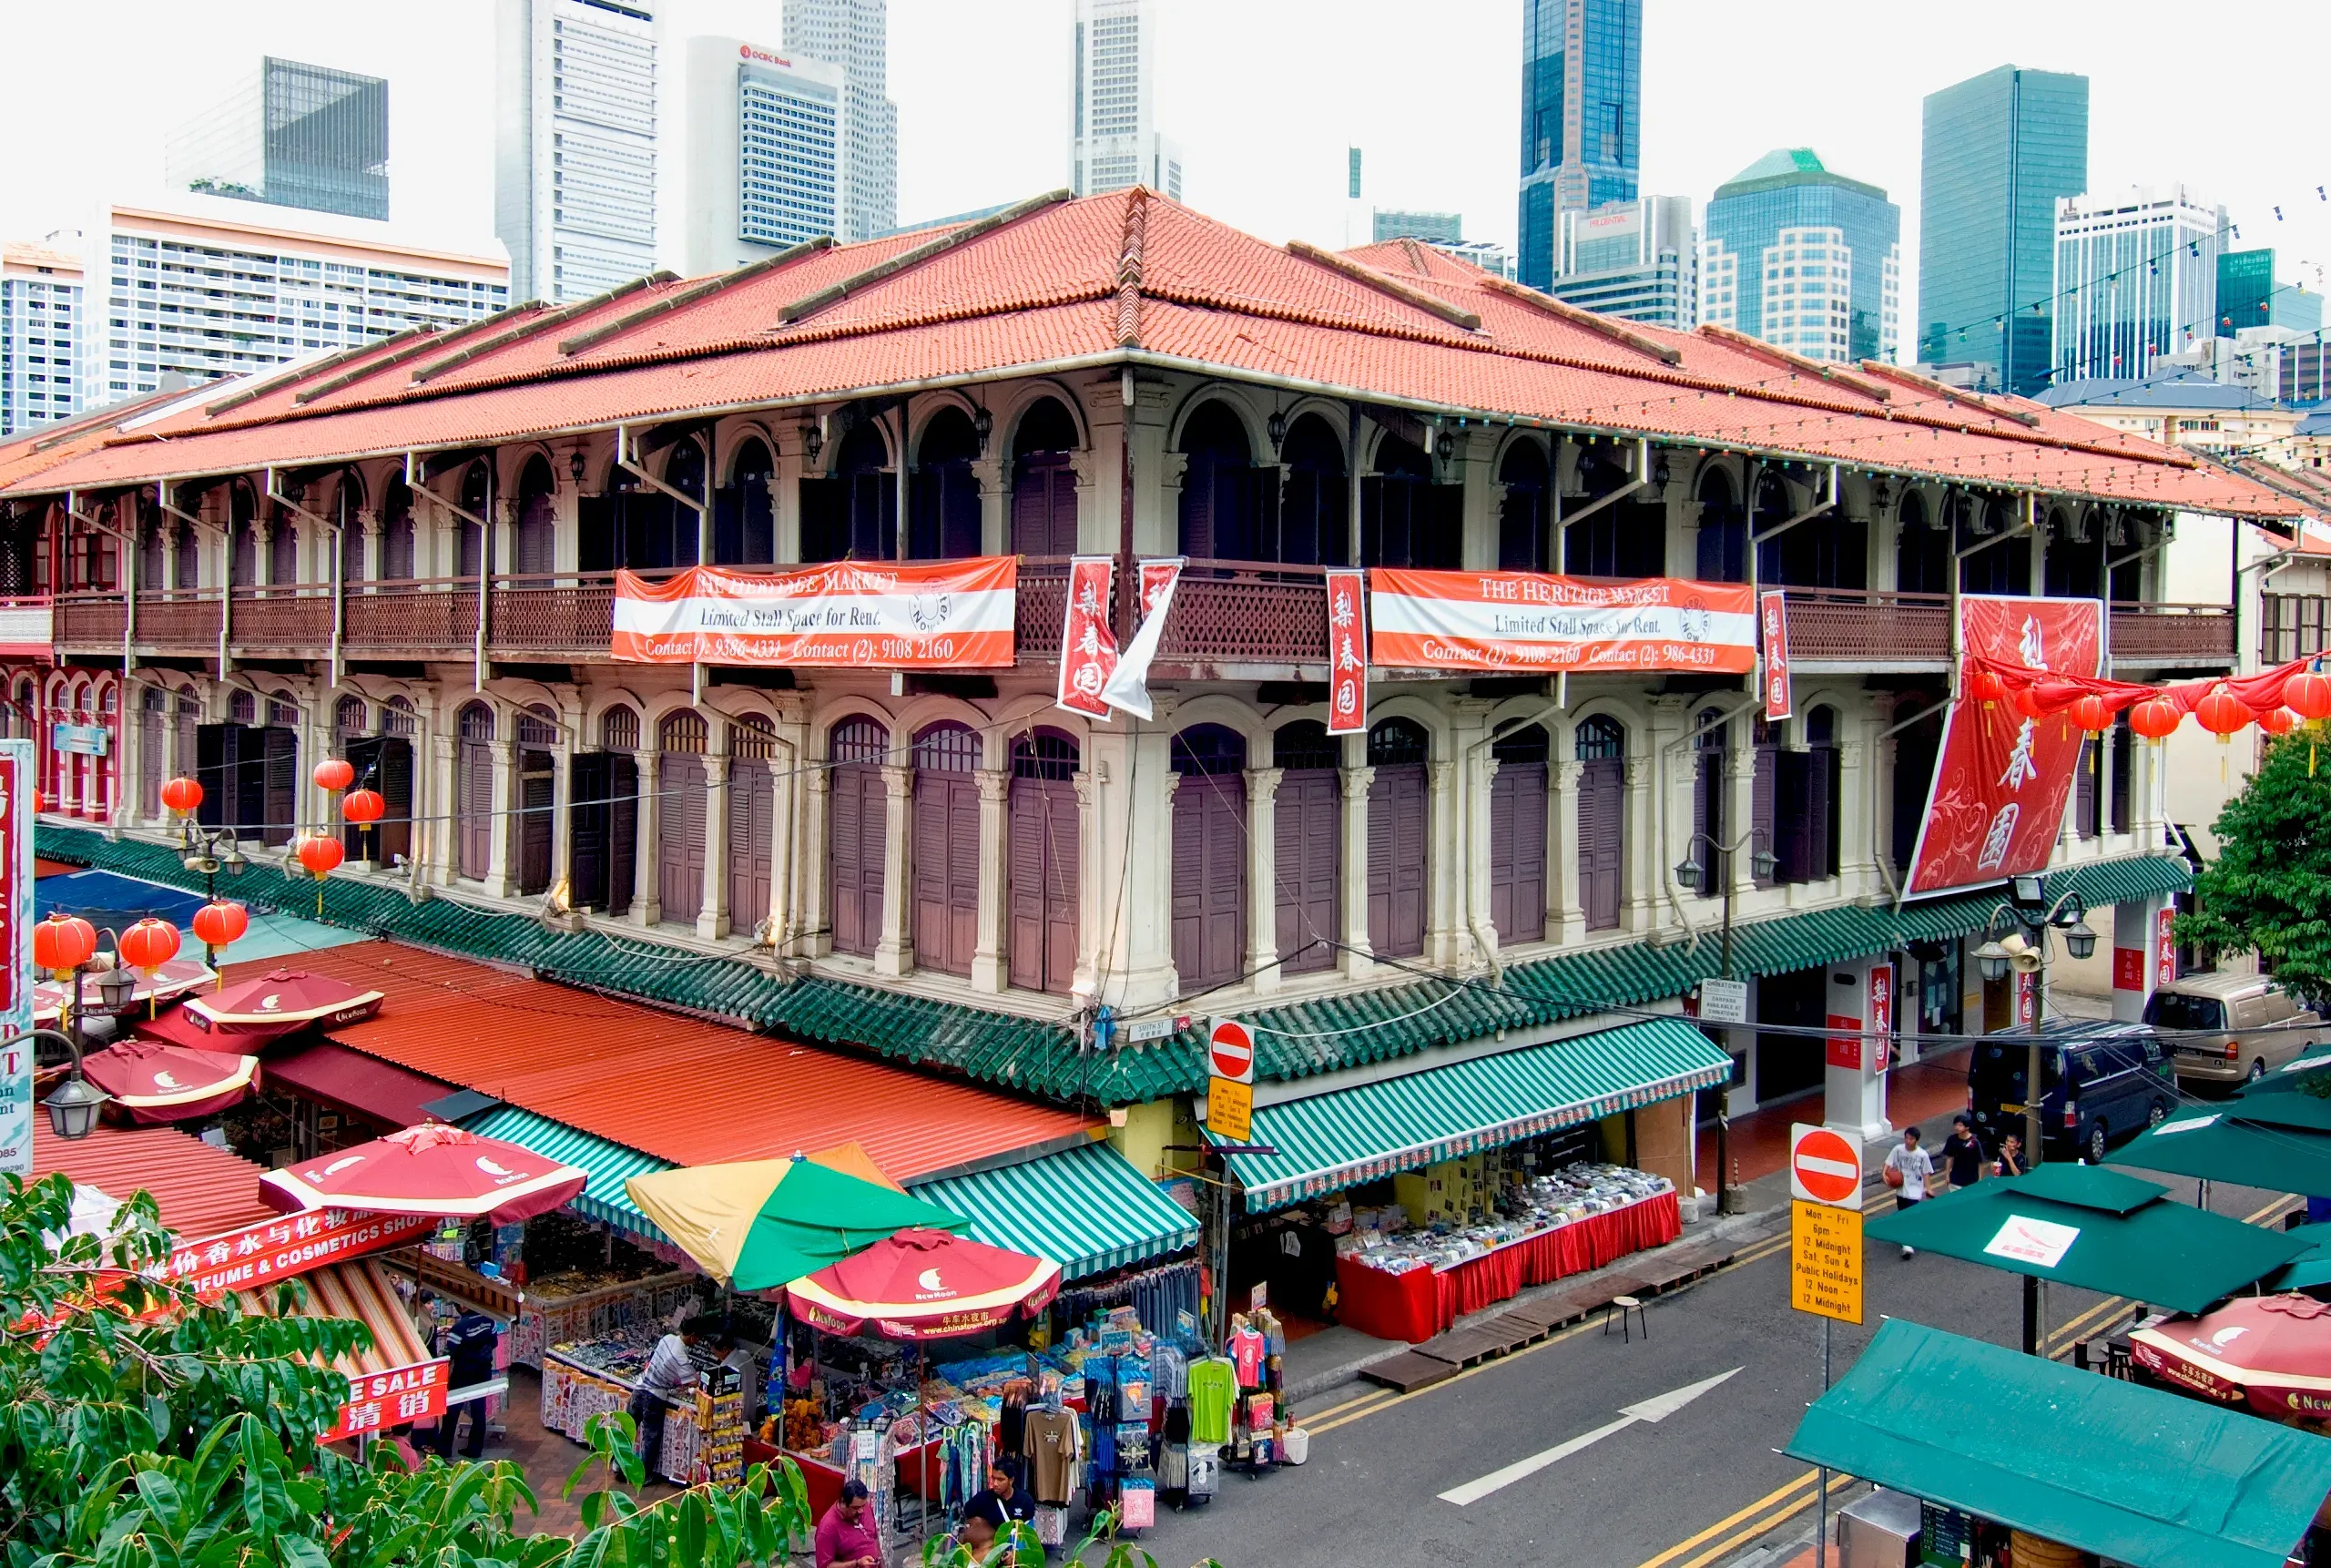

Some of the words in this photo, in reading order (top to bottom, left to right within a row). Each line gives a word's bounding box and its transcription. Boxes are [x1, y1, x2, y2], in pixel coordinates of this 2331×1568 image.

[752, 51, 772, 63] OCBC
[729, 574, 819, 595] HERITAGE
[823, 571, 899, 591] MARKET
[1479, 577, 1517, 600] THE
[1522, 581, 1608, 605] HERITAGE
[701, 607, 749, 627] Limited
[753, 609, 782, 627] Stall
[787, 609, 822, 632] Space
[826, 607, 847, 626] for
[1495, 615, 1544, 634] Limited
[1549, 616, 1576, 635] Stall
[1580, 618, 1612, 639] Space
[1634, 617, 1661, 634] Rent.
[645, 638, 692, 657] Contact
[715, 638, 781, 658] 9386-4331
[793, 639, 849, 658] Contact
[852, 639, 878, 663] (2):
[882, 639, 912, 659] 9108
[917, 639, 953, 659] 2160
[1515, 645, 1580, 665] 9108-2160
[1590, 646, 1636, 664] Contact
[1640, 645, 1659, 667] (2):
[1663, 645, 1715, 665] 986-4331
[1706, 981, 1743, 990] CHINATOWN
[1805, 1207, 1822, 1221] Mon
[1837, 1213, 1849, 1227] Fri
[1813, 1224, 1830, 1237] 6pm
[258, 1259, 271, 1275] &
[276, 1225, 380, 1269] COSMETICS
[1803, 1236, 1811, 1247] 12
[1816, 1238, 1852, 1256] Midnight
[1824, 1254, 1840, 1267] Sun
[1844, 1257, 1850, 1269] &
[1796, 1261, 1820, 1277] Public
[1822, 1268, 1858, 1286] Holidays
[915, 1289, 957, 1301] NewMoon
[1805, 1278, 1813, 1290] 12
[1817, 1281, 1839, 1297] Noon
[1803, 1293, 1811, 1305] 12
[1815, 1297, 1852, 1315] Midnight
[371, 1365, 437, 1397] SALE
